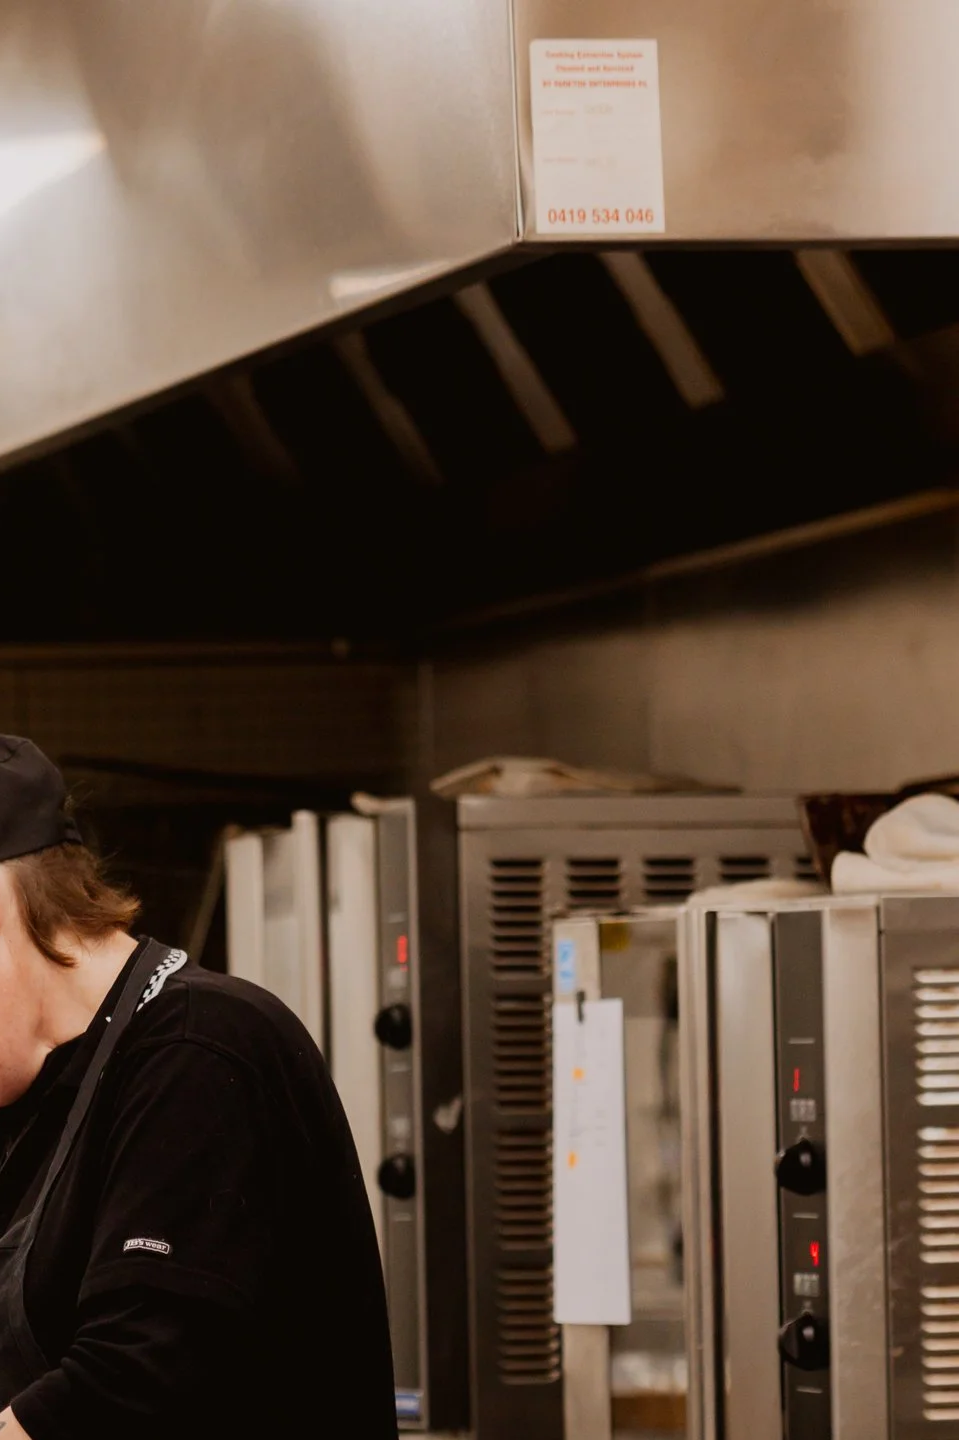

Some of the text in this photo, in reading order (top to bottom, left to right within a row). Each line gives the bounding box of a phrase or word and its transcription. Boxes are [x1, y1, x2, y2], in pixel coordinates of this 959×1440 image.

[547, 207, 654, 224] 0419 534 046
[145, 1241, 167, 1251] wear
